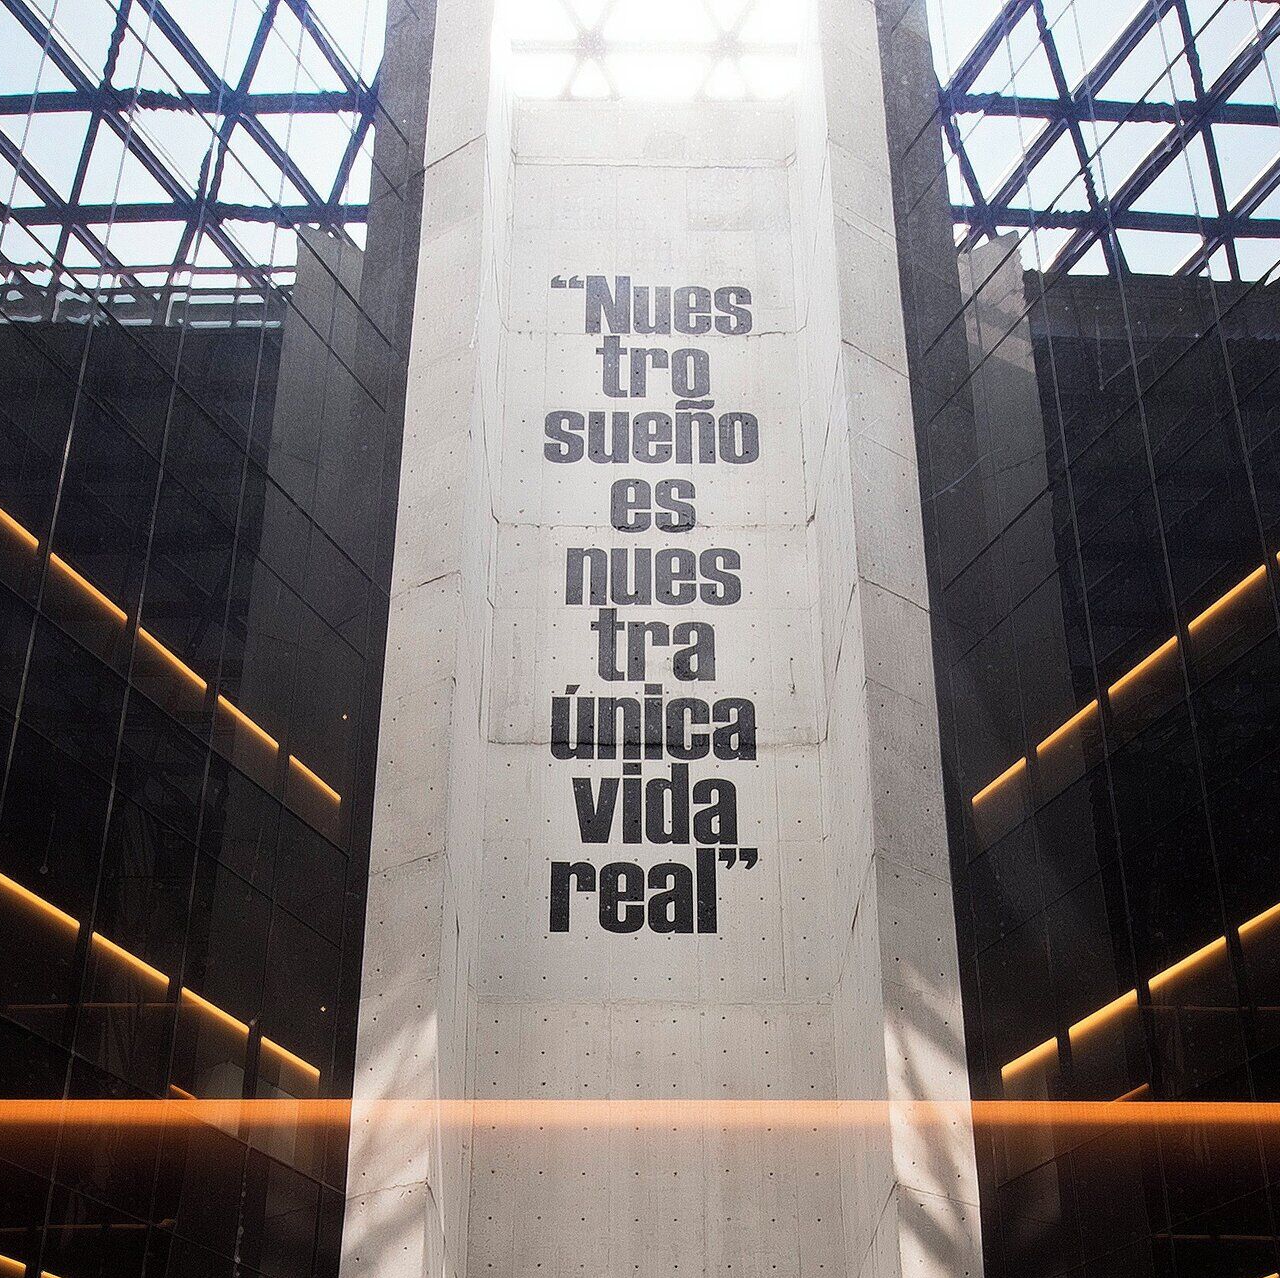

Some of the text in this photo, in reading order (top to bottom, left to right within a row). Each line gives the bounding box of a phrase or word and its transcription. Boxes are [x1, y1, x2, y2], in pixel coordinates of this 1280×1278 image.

[551, 274, 752, 336] “Nues
[597, 333, 712, 402] tro
[543, 399, 759, 466] sueño
[610, 474, 697, 534] es
[565, 543, 742, 606] nues
[597, 606, 716, 682] tra
[550, 684, 758, 761] única
[571, 763, 739, 845] vida
[549, 847, 759, 934] real”
